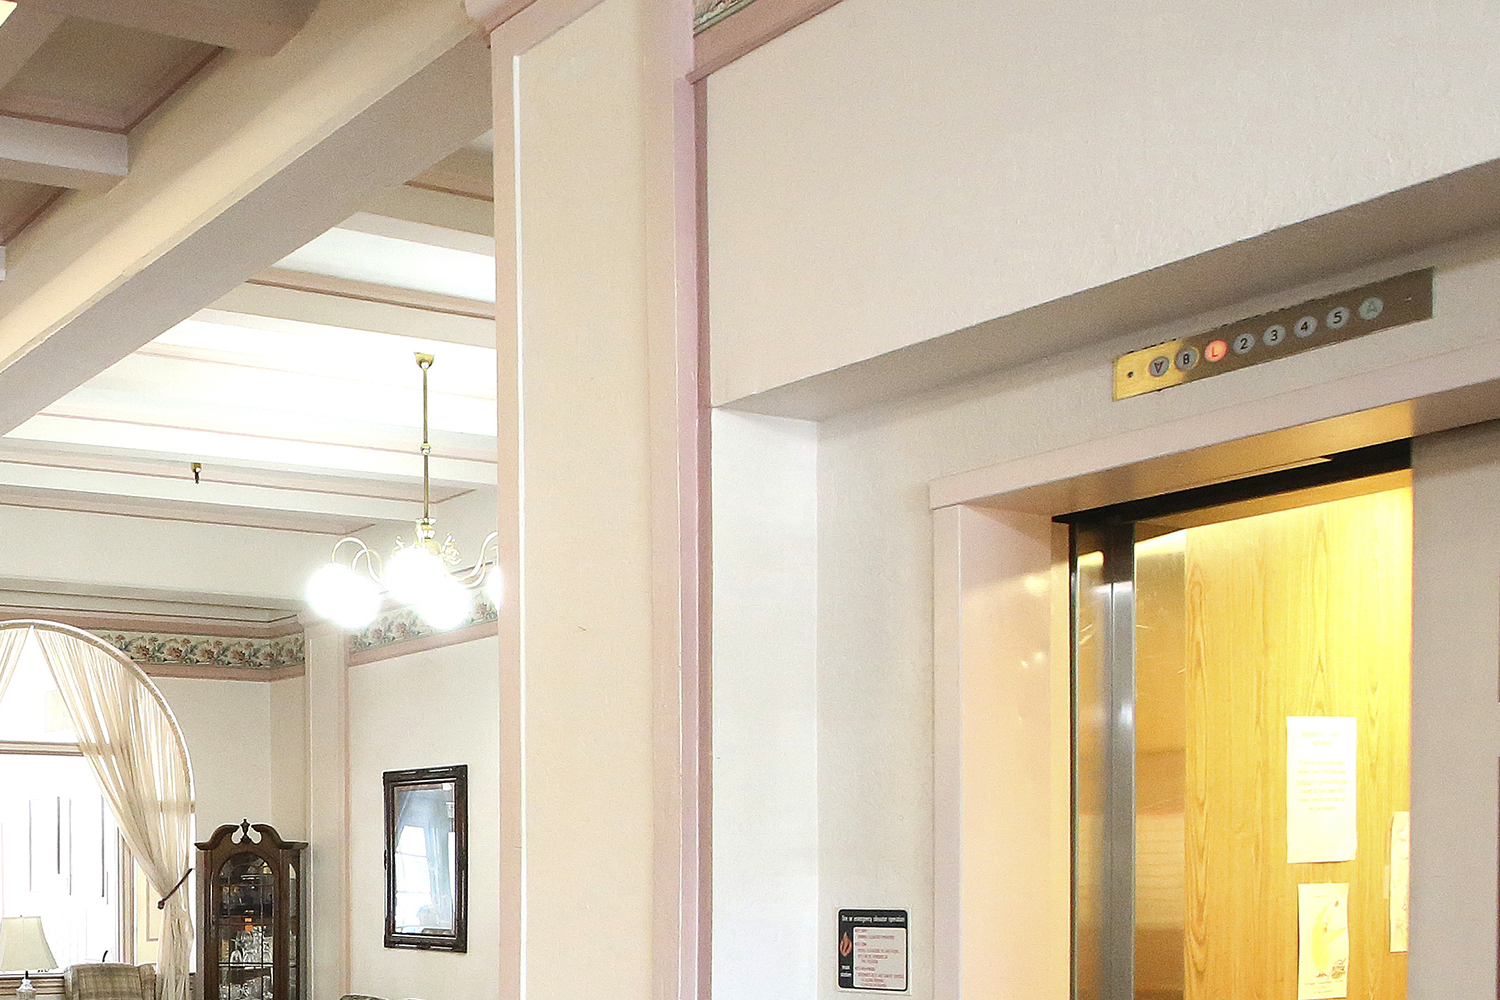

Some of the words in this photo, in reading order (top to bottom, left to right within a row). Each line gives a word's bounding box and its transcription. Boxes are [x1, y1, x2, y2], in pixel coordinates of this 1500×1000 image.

[1211, 346, 1218, 357] L
[1240, 337, 1248, 350] 2
[1270, 329, 1278, 342] 3
[1300, 321, 1308, 332] 4
[1333, 311, 1342, 324] 5
